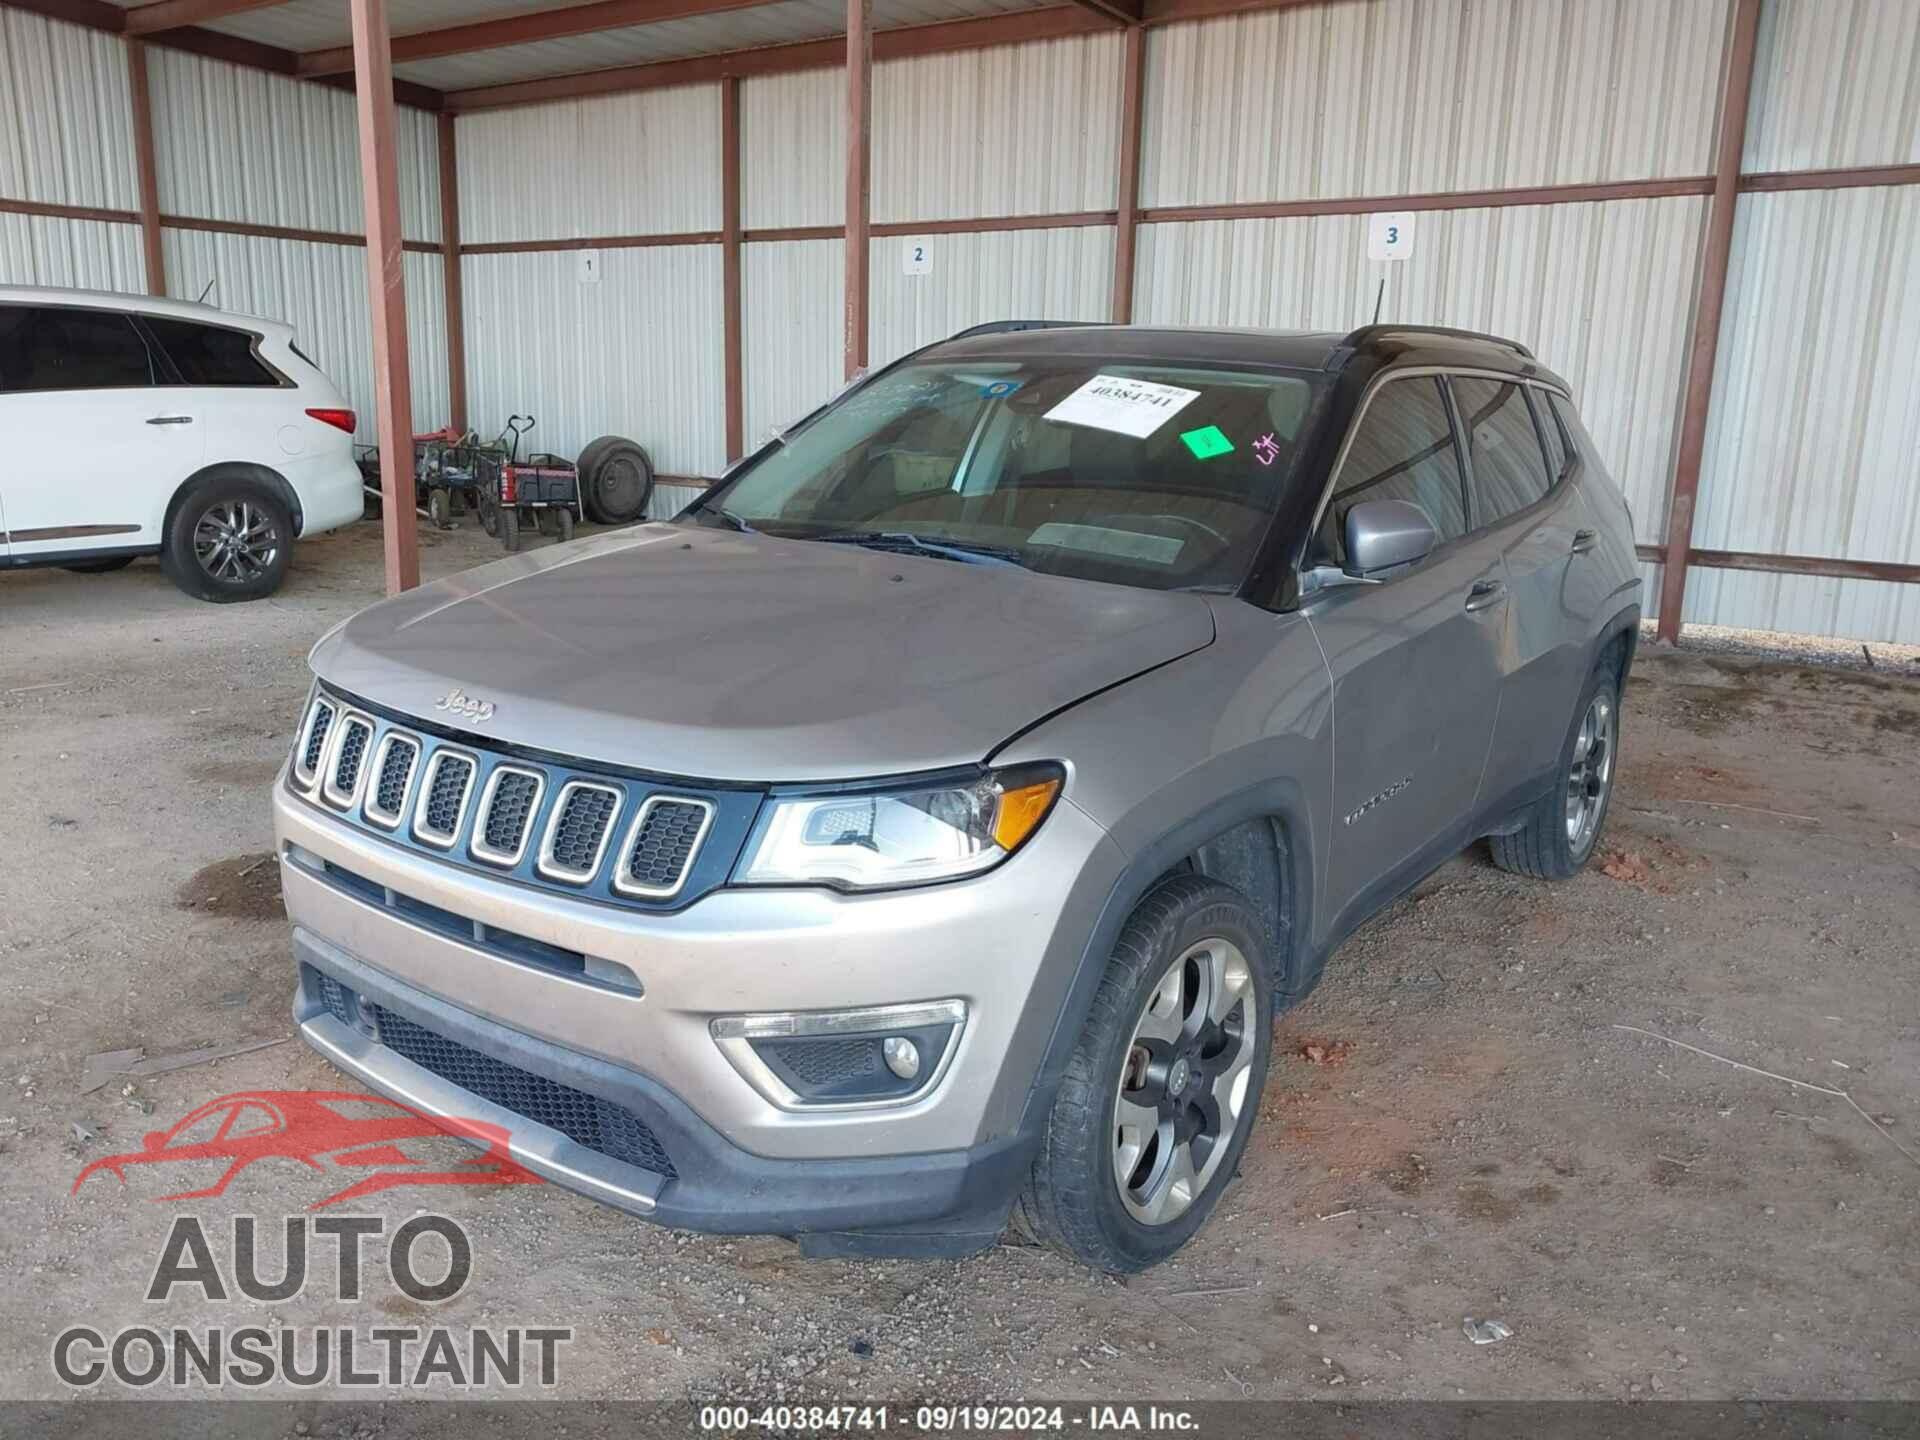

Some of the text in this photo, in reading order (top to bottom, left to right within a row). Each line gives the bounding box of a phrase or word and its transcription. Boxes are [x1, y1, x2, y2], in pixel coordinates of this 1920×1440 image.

[1386, 227, 1398, 244] 3
[914, 247, 923, 262] 2
[1090, 385, 1173, 408] 40384741
[435, 688, 495, 724] Jeep
